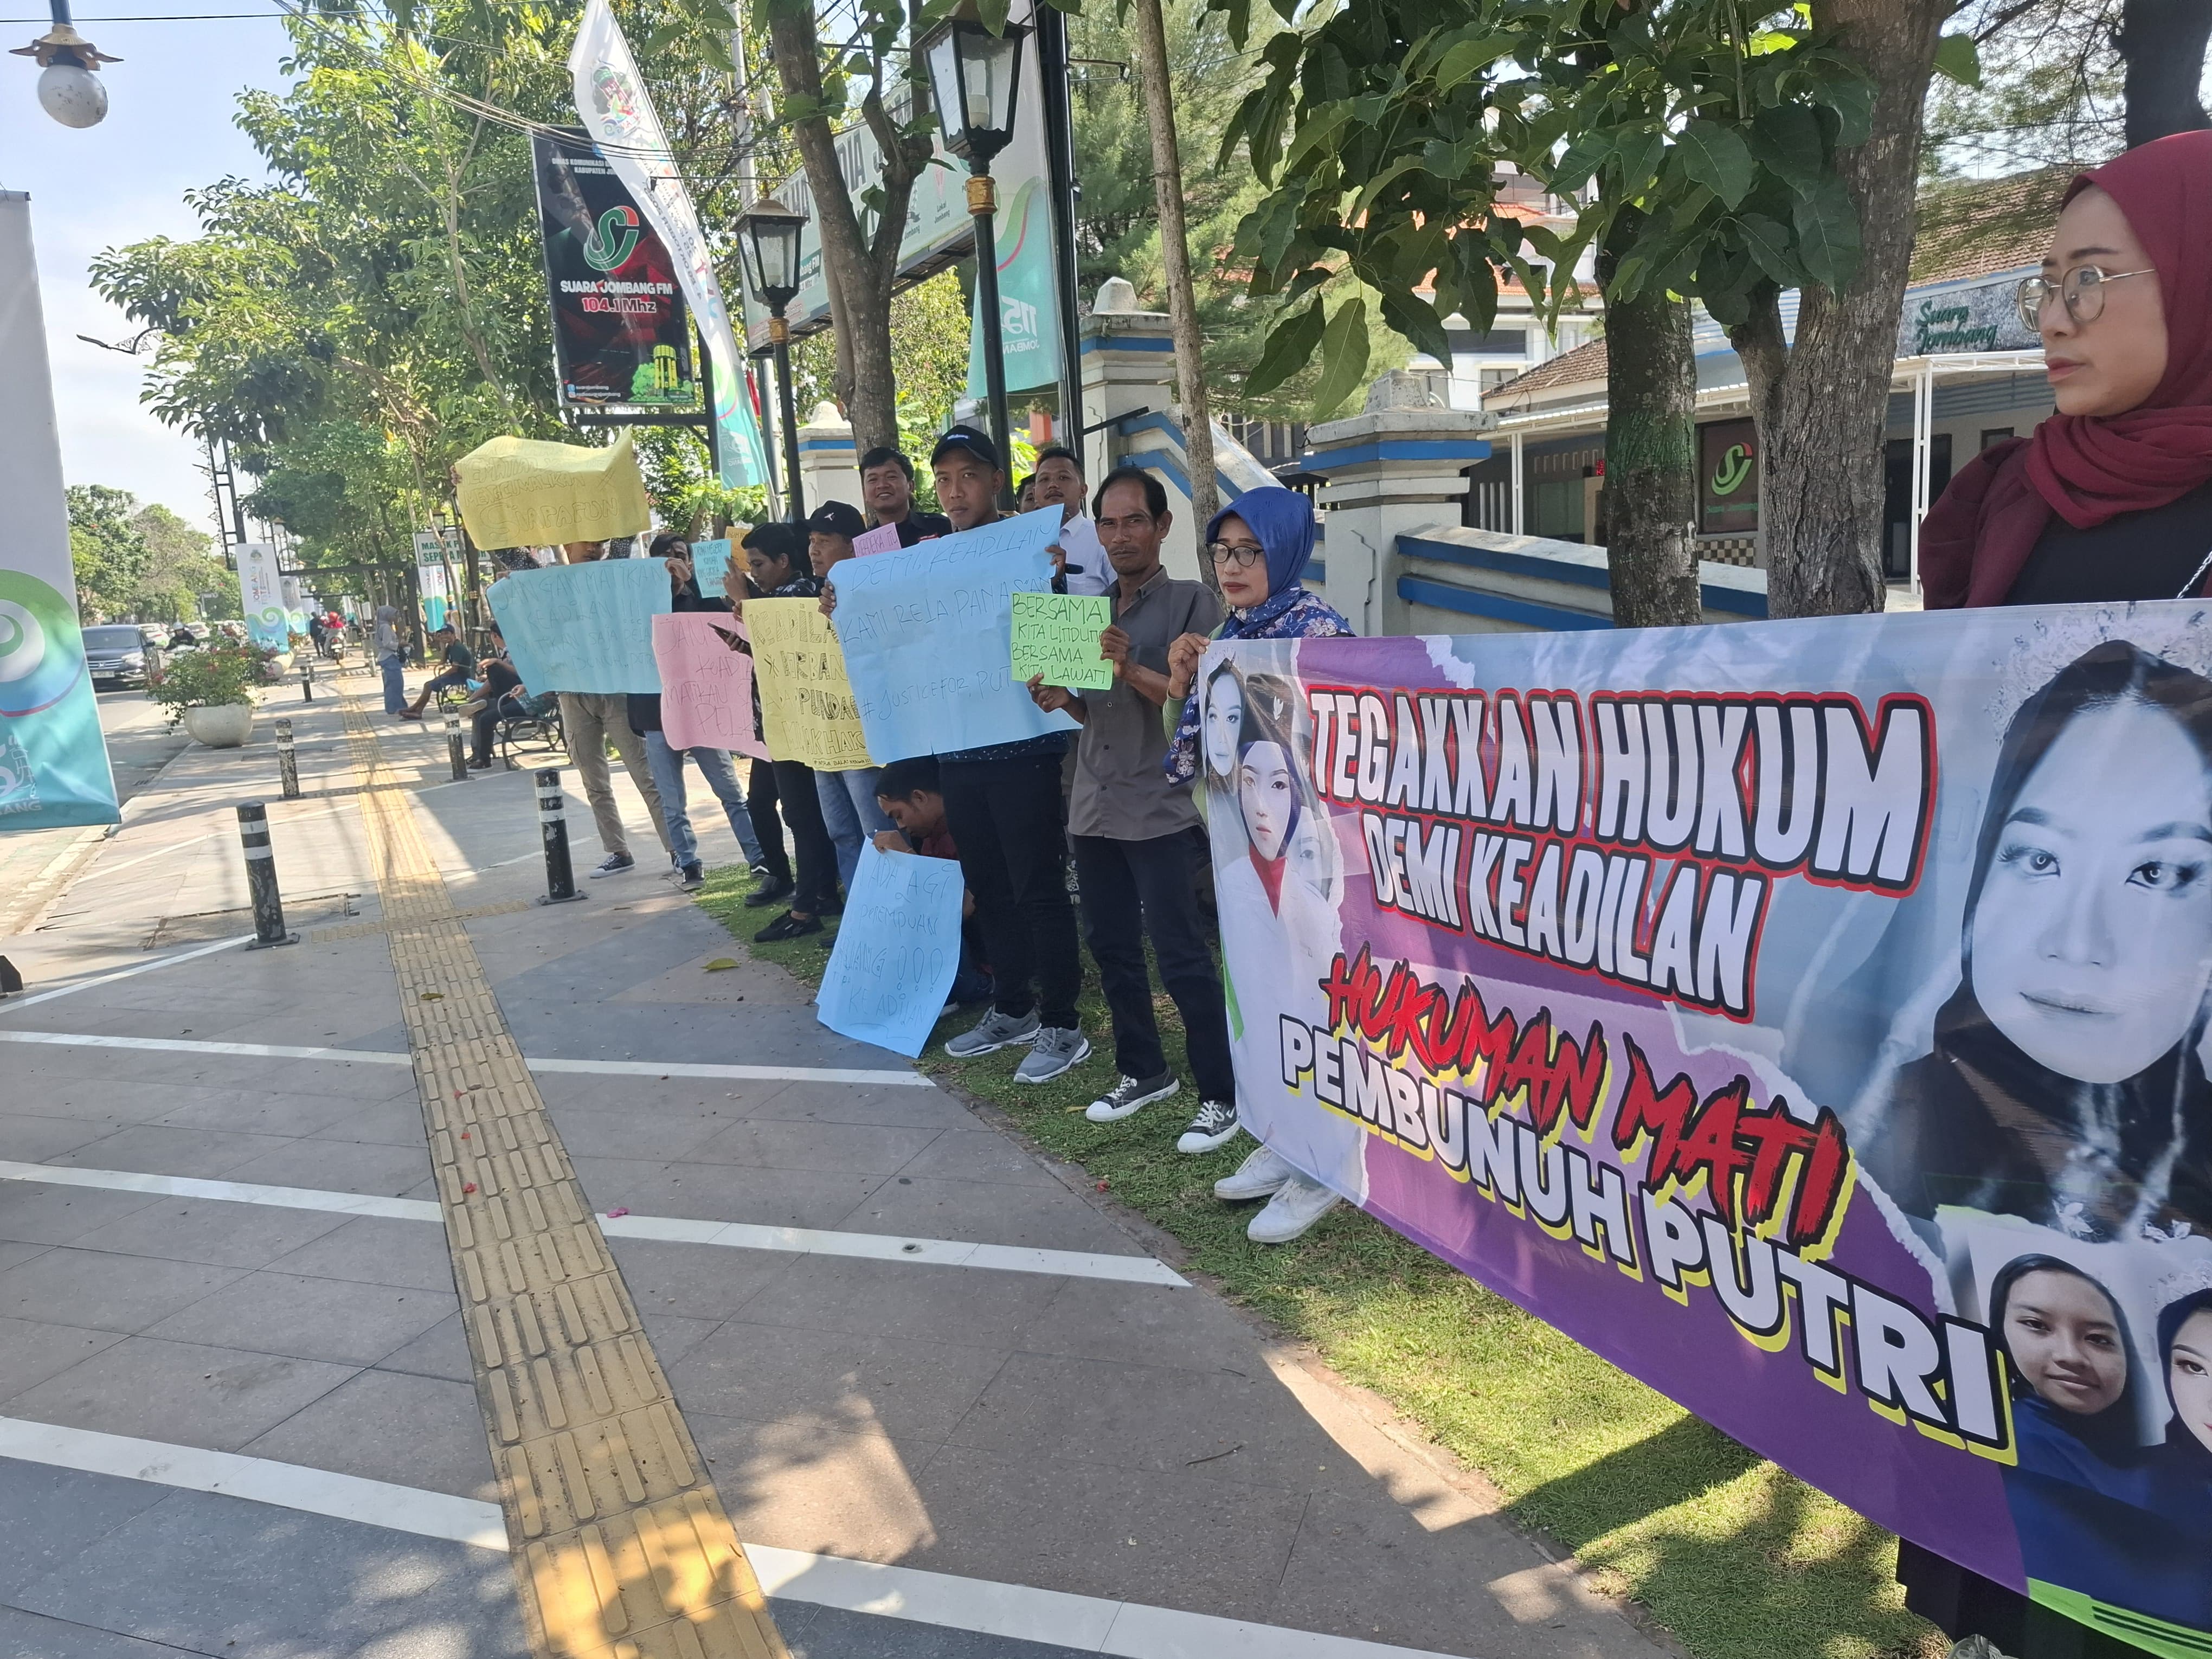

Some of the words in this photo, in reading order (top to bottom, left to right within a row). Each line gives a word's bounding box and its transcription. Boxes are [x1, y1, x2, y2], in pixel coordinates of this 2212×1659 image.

[560, 280, 598, 293] SUARA
[600, 281, 655, 294] JOMBANG
[656, 282, 673, 295] FM
[582, 297, 621, 313] 104.1
[623, 299, 657, 313] Mhz
[1916, 324, 1998, 354] Jombang
[421, 541, 452, 550] MASK
[423, 550, 455, 562] SEPEA
[1012, 593, 1104, 625] BERSAMA
[1018, 622, 1046, 640] KITA
[1012, 642, 1083, 665] BERSAMA
[976, 665, 1012, 698] PUT
[1307, 692, 1587, 838] TEGAKKAN
[1594, 697, 1926, 885] HUKUM
[0, 799, 42, 815] ANG
[1362, 811, 1464, 930] DEMI
[1468, 829, 1769, 1017] KEADILAN
[1320, 941, 1609, 1136] HUKUMAN
[1613, 1033, 1848, 1248] MATI
[1280, 1013, 1638, 1271] PEMBUNUH
[1641, 1187, 2011, 1451] PUTRI
